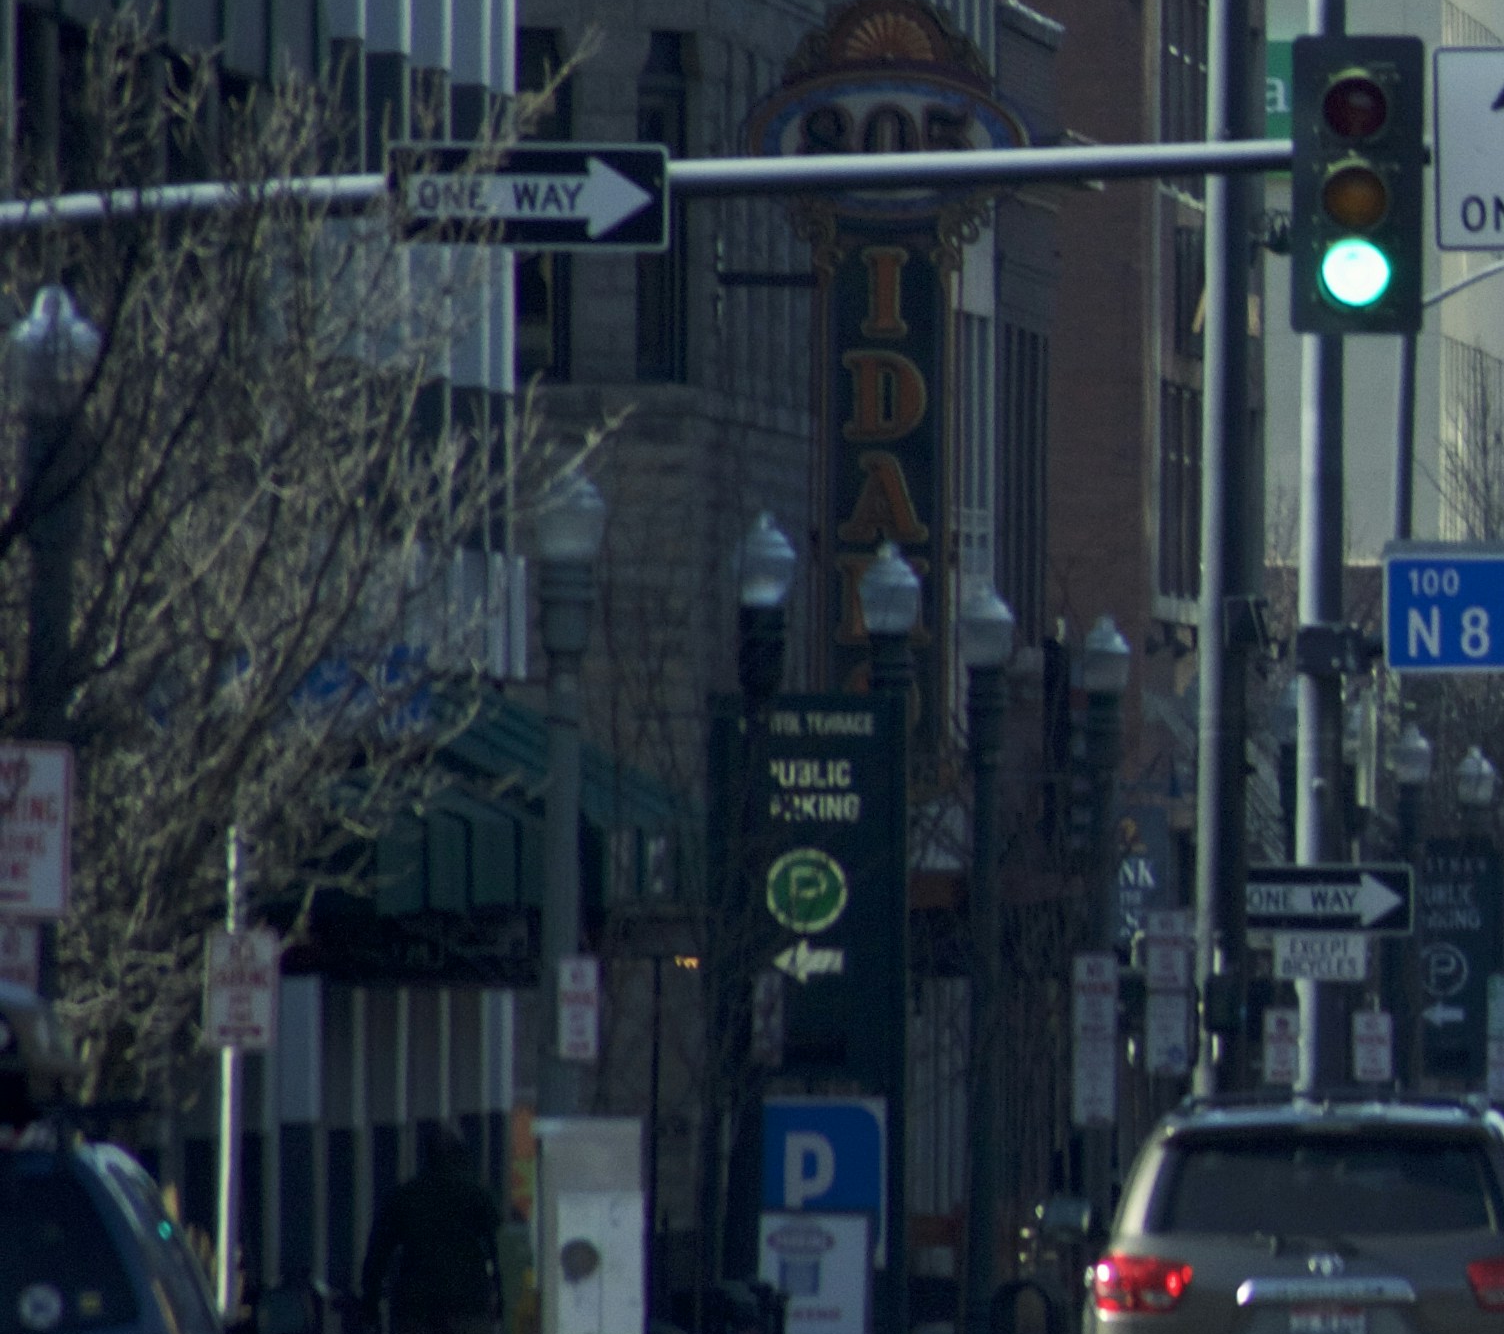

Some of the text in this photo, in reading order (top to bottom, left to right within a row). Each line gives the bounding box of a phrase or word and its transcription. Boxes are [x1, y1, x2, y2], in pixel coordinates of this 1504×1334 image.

[417, 179, 584, 213] ONE WAY
[1408, 568, 1460, 597] 100
[1407, 605, 1441, 658] N
[1459, 605, 1491, 658] 8
[1248, 892, 1360, 913] ONE WAY
[1289, 939, 1349, 955] EXCEPT
[1281, 958, 1358, 976] BICYCLES
